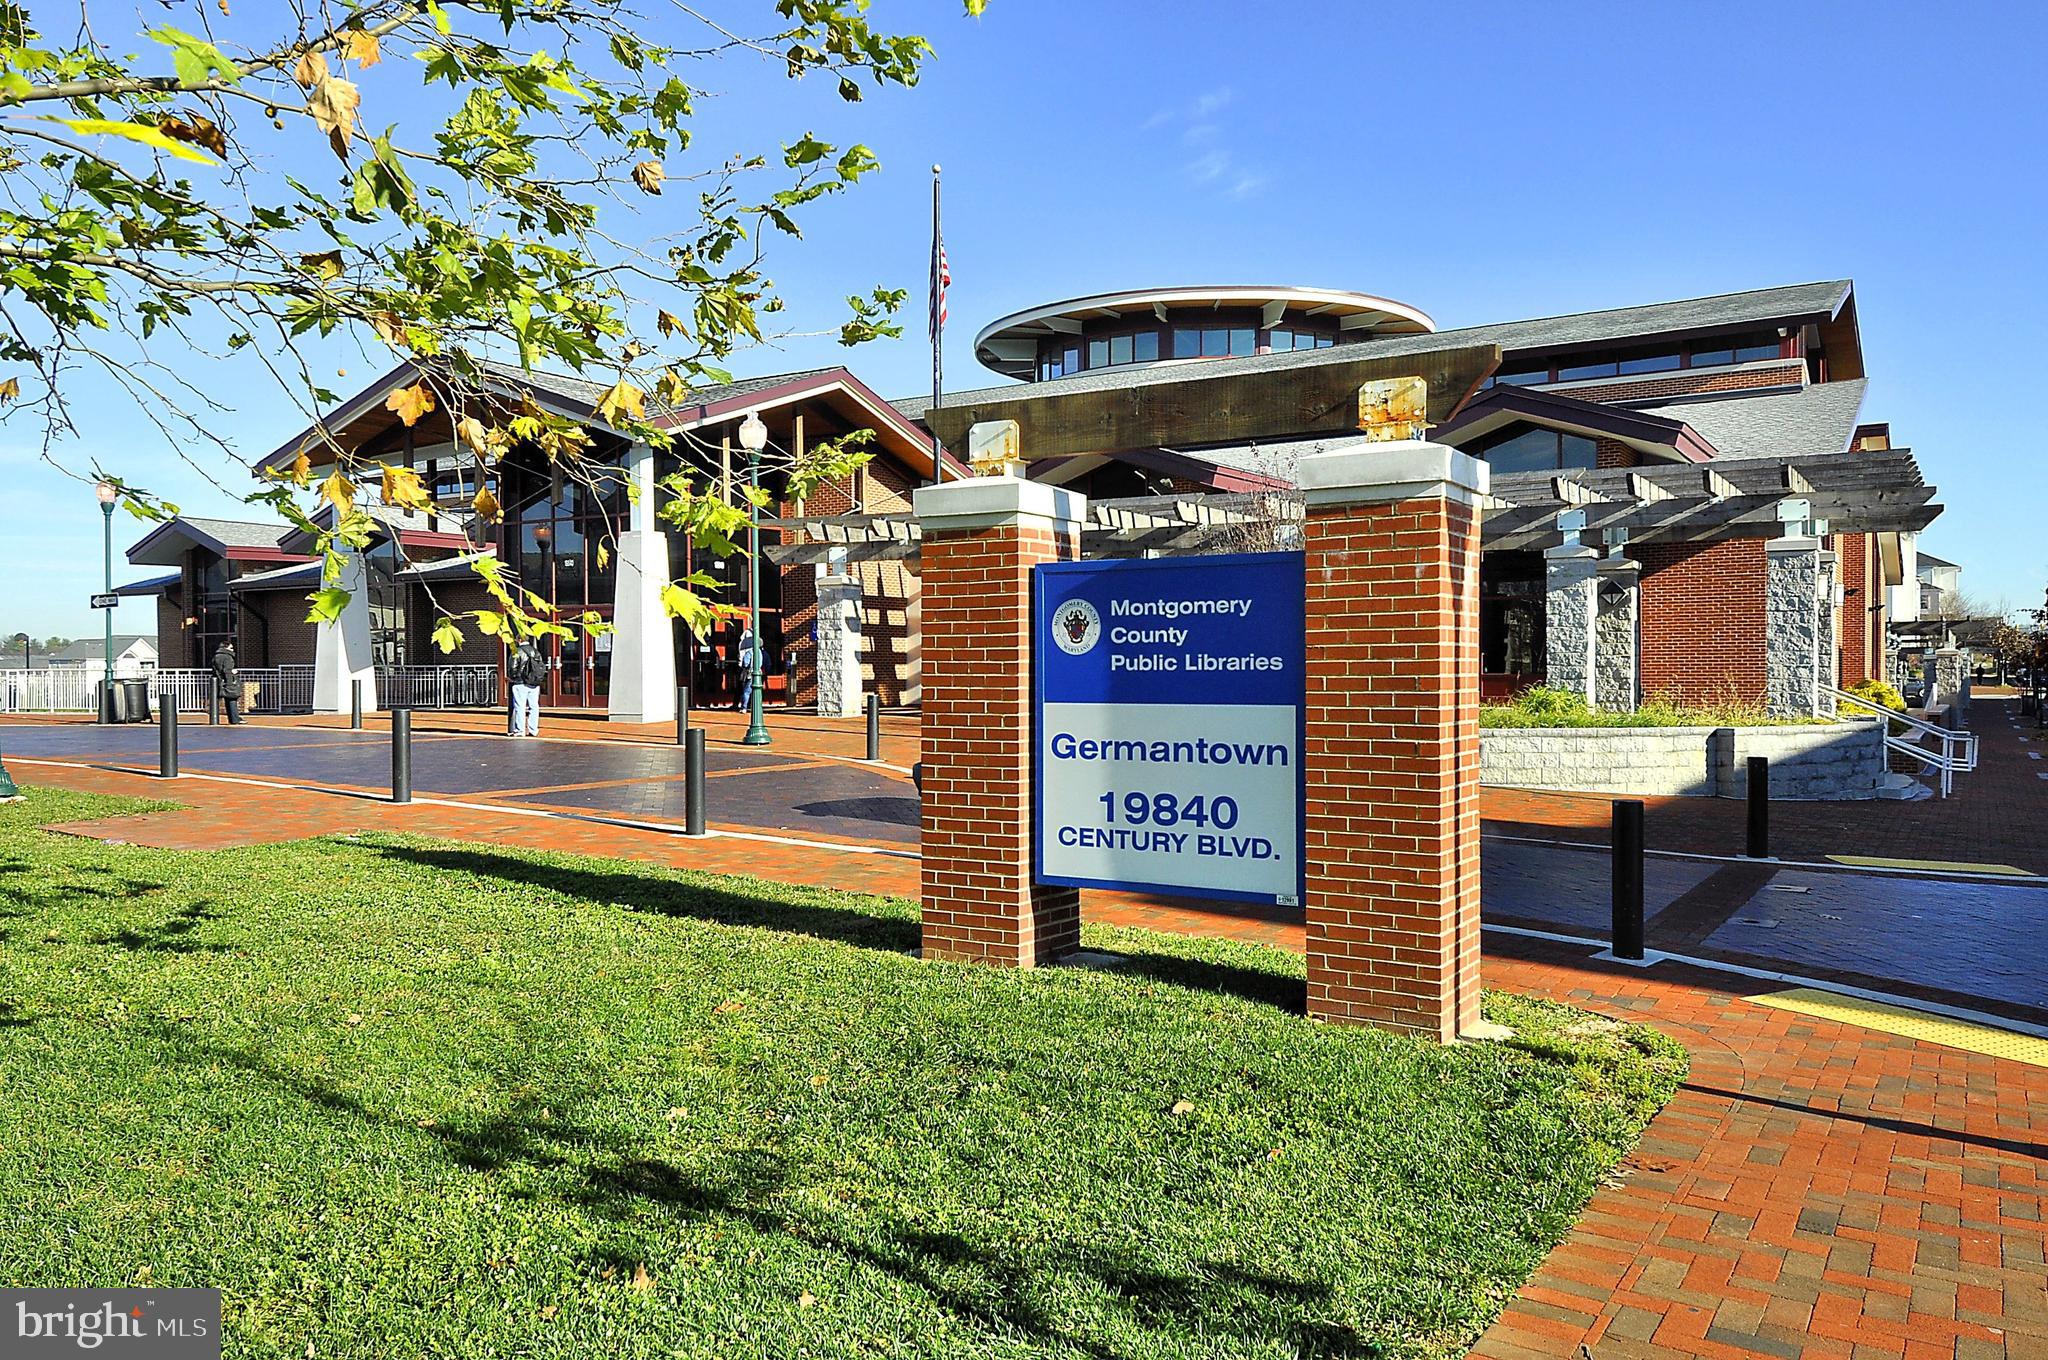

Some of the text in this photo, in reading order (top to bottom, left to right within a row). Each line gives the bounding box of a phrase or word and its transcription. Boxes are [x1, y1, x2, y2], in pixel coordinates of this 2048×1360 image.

[1054, 601, 1083, 626] MONTGOMERY
[1110, 599, 1252, 618] Montgomery
[1110, 627, 1188, 646] County
[1063, 644, 1091, 653] MARYLAND
[1111, 653, 1284, 671] Public Libraries
[1051, 733, 1288, 765] Germantown
[1099, 791, 1239, 830] 19840
[1058, 826, 1281, 860] CENTURY BLVD.
